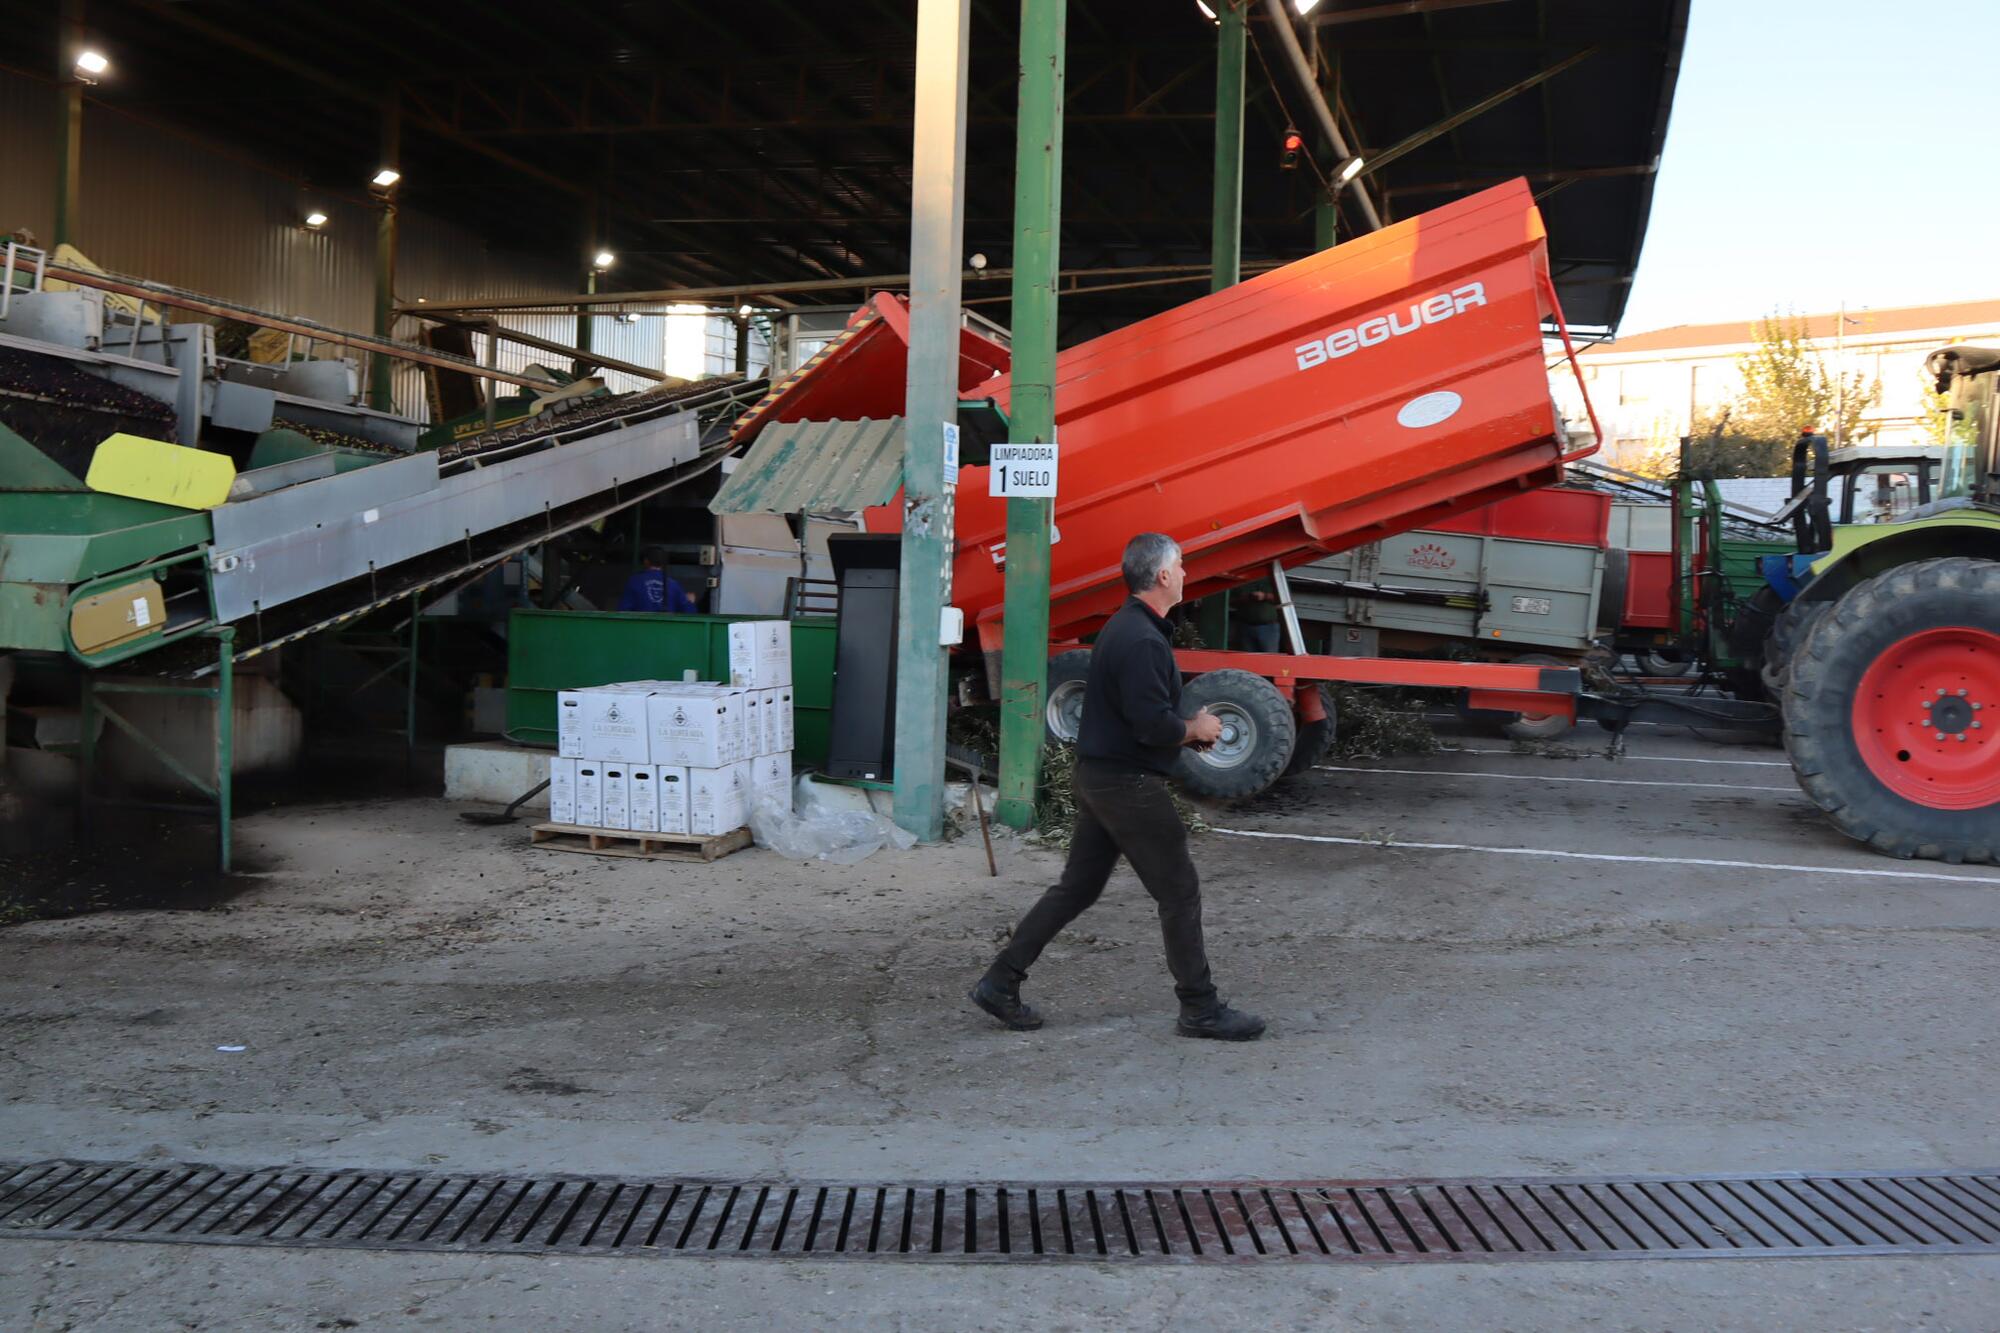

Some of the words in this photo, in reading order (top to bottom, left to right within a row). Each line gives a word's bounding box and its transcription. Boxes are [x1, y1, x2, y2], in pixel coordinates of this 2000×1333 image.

[994, 447, 1053, 461] LIMPIADORA
[999, 465, 1007, 493] 1
[1013, 471, 1050, 486] SUELO
